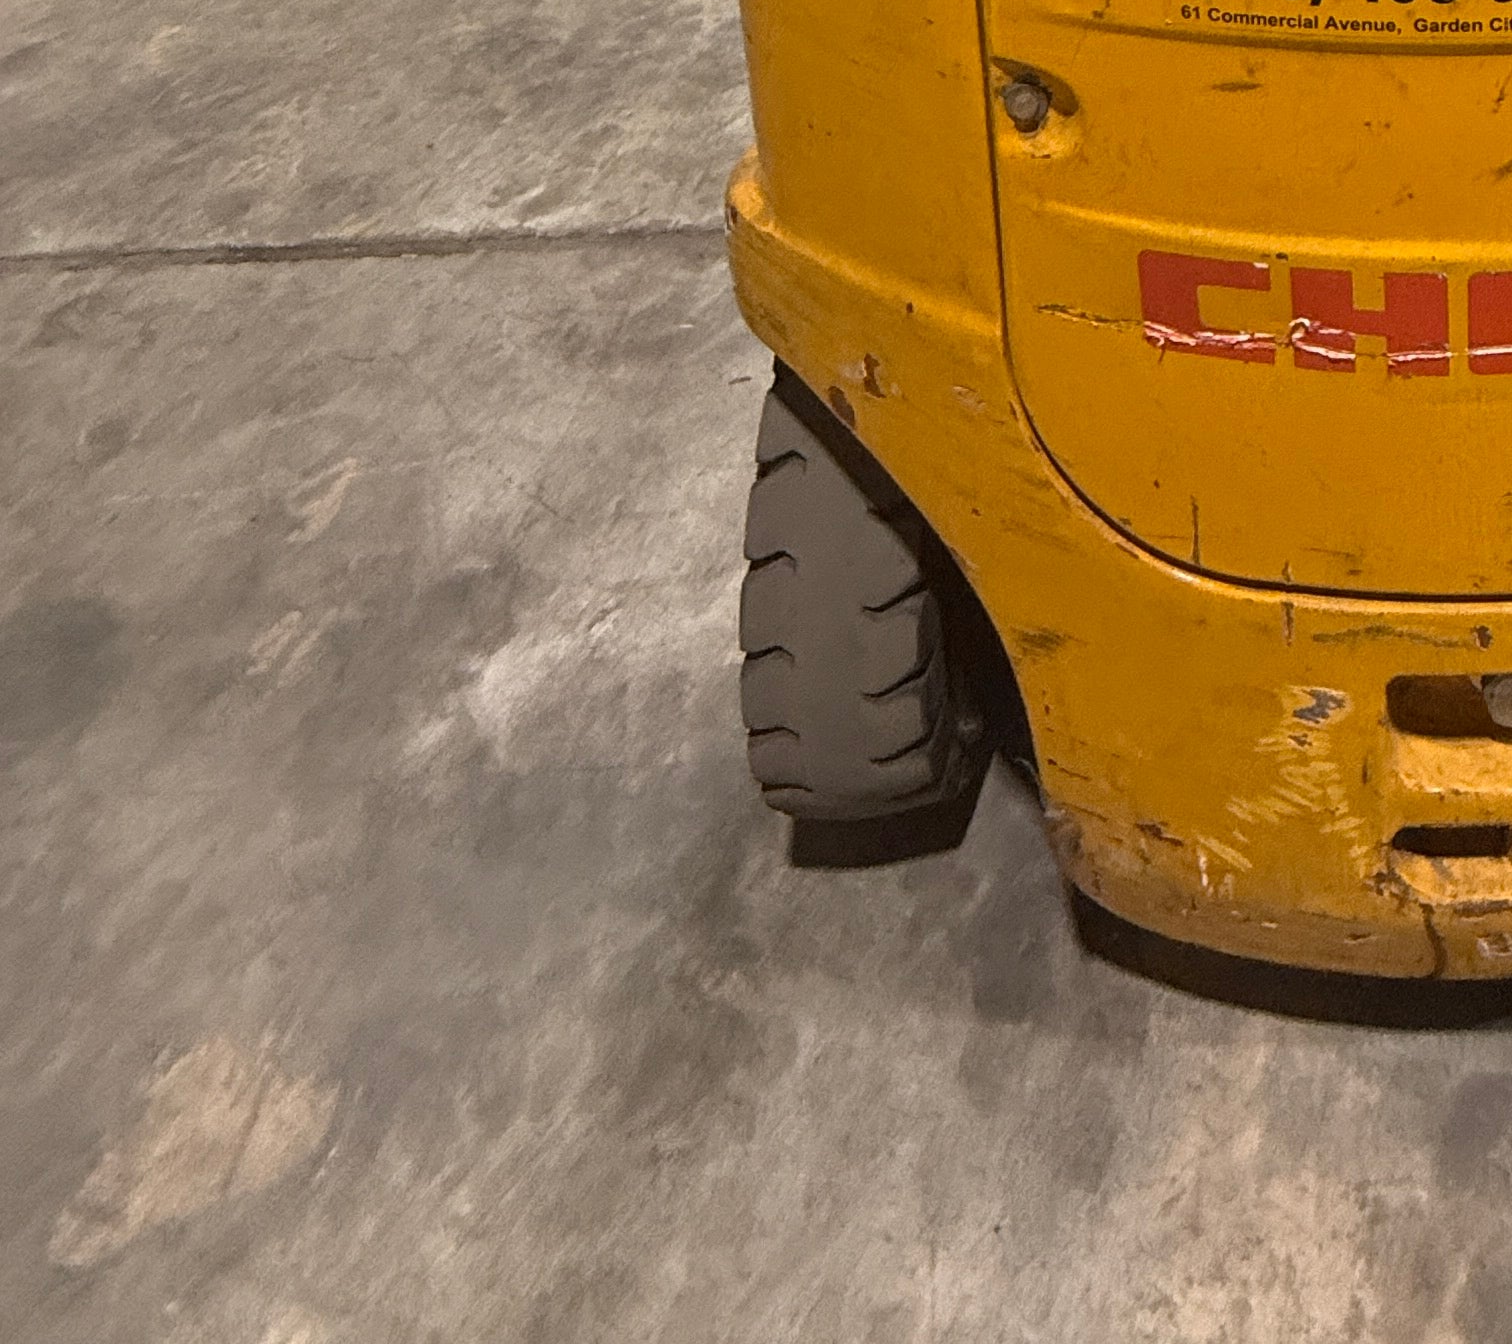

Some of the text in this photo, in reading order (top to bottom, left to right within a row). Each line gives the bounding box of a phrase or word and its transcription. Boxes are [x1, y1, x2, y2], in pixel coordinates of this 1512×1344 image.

[1181, 5, 1200, 20] 61
[1207, 7, 1319, 30] Commercial
[1325, 15, 1402, 35] Avenue,
[1414, 17, 1484, 33] Garden
